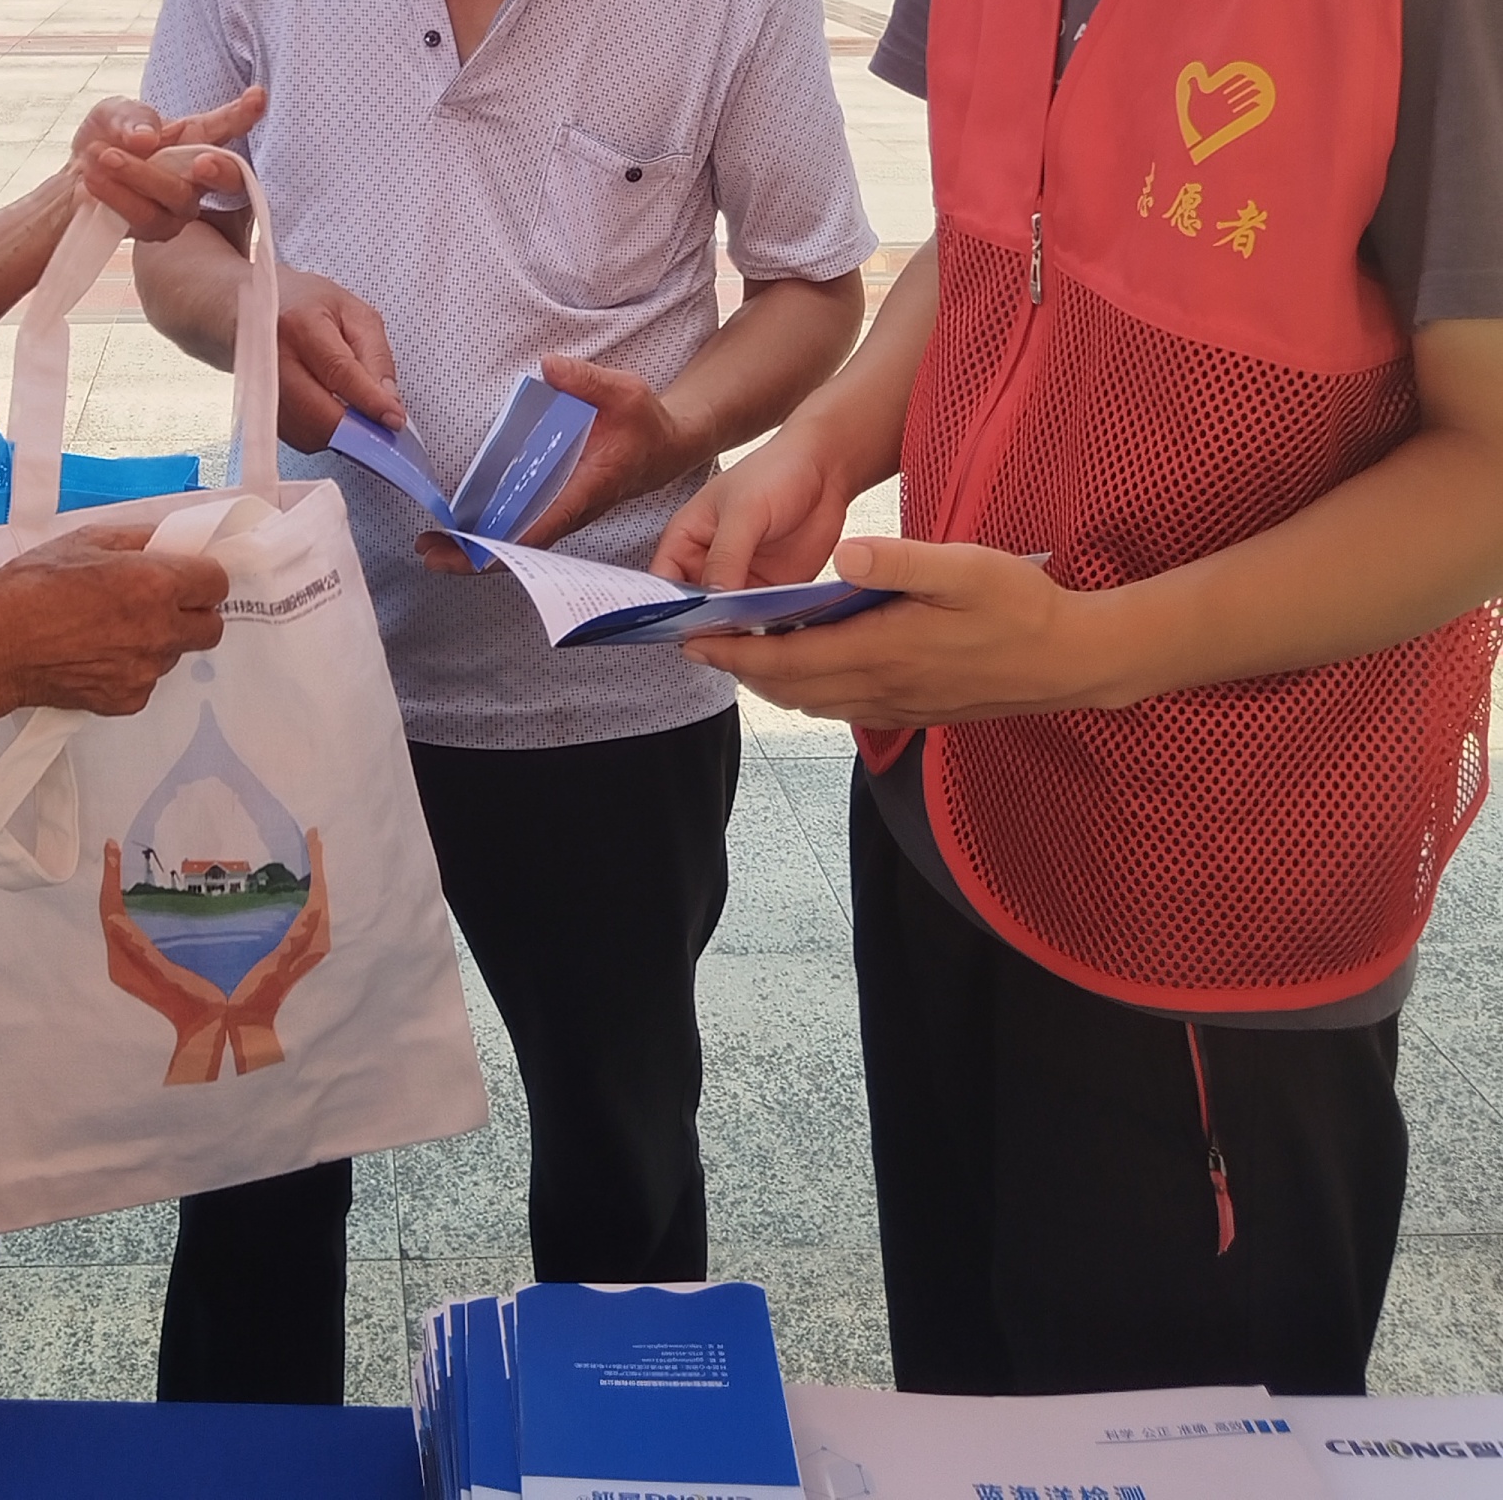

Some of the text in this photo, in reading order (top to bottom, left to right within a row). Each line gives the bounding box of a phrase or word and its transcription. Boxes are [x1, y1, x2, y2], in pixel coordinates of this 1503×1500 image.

[1104, 1427, 1134, 1442] 科学
[1142, 1425, 1172, 1440] 公正
[1324, 1438, 1503, 1461] CHIONG智
